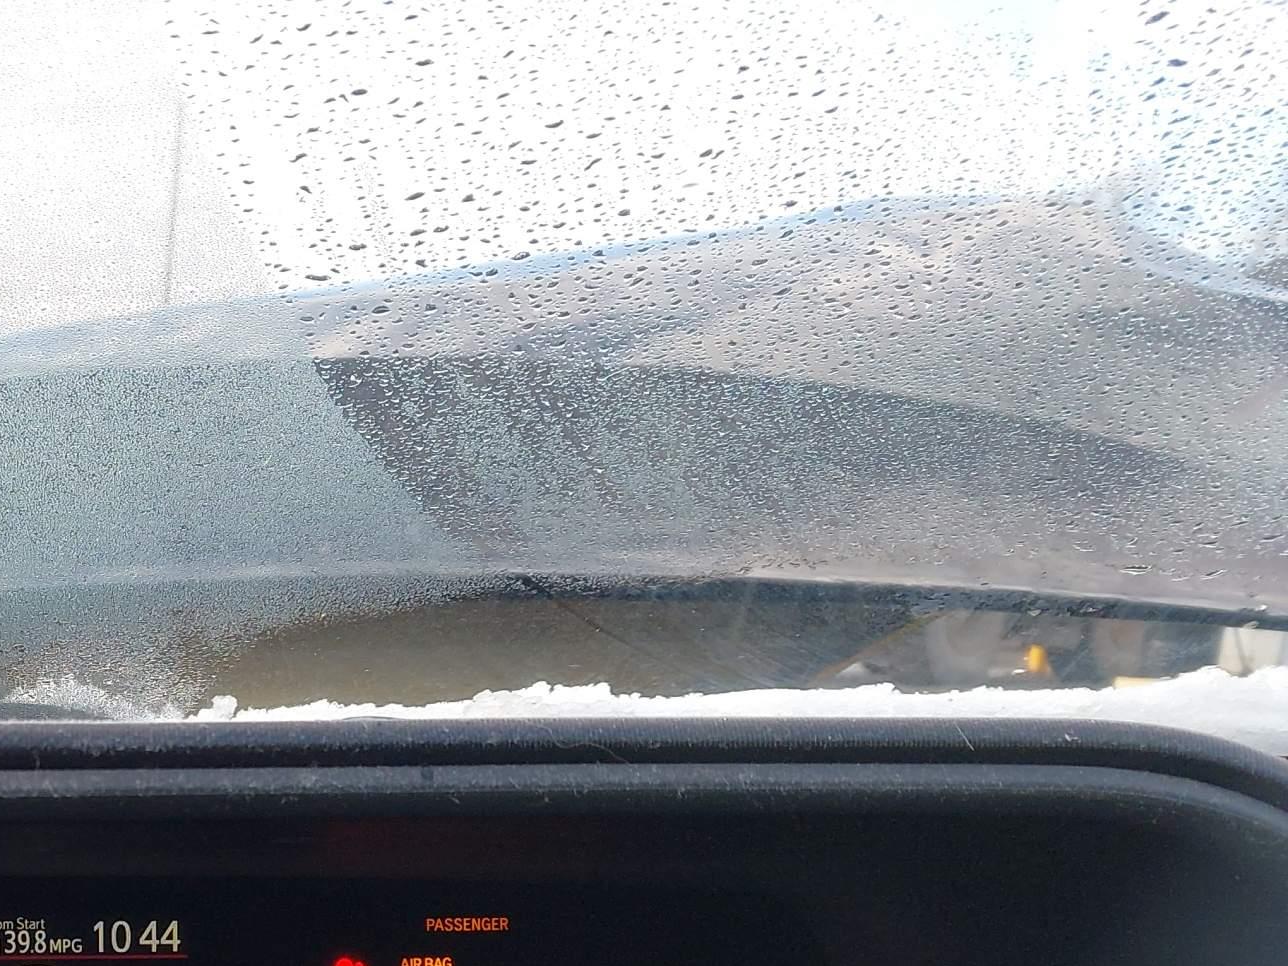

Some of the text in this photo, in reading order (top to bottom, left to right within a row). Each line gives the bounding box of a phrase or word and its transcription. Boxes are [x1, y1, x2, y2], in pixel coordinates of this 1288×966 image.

[16, 917, 45, 930] Start
[426, 917, 509, 931] PASSENGER
[4, 931, 47, 954] 39.8
[49, 939, 83, 953] MPG
